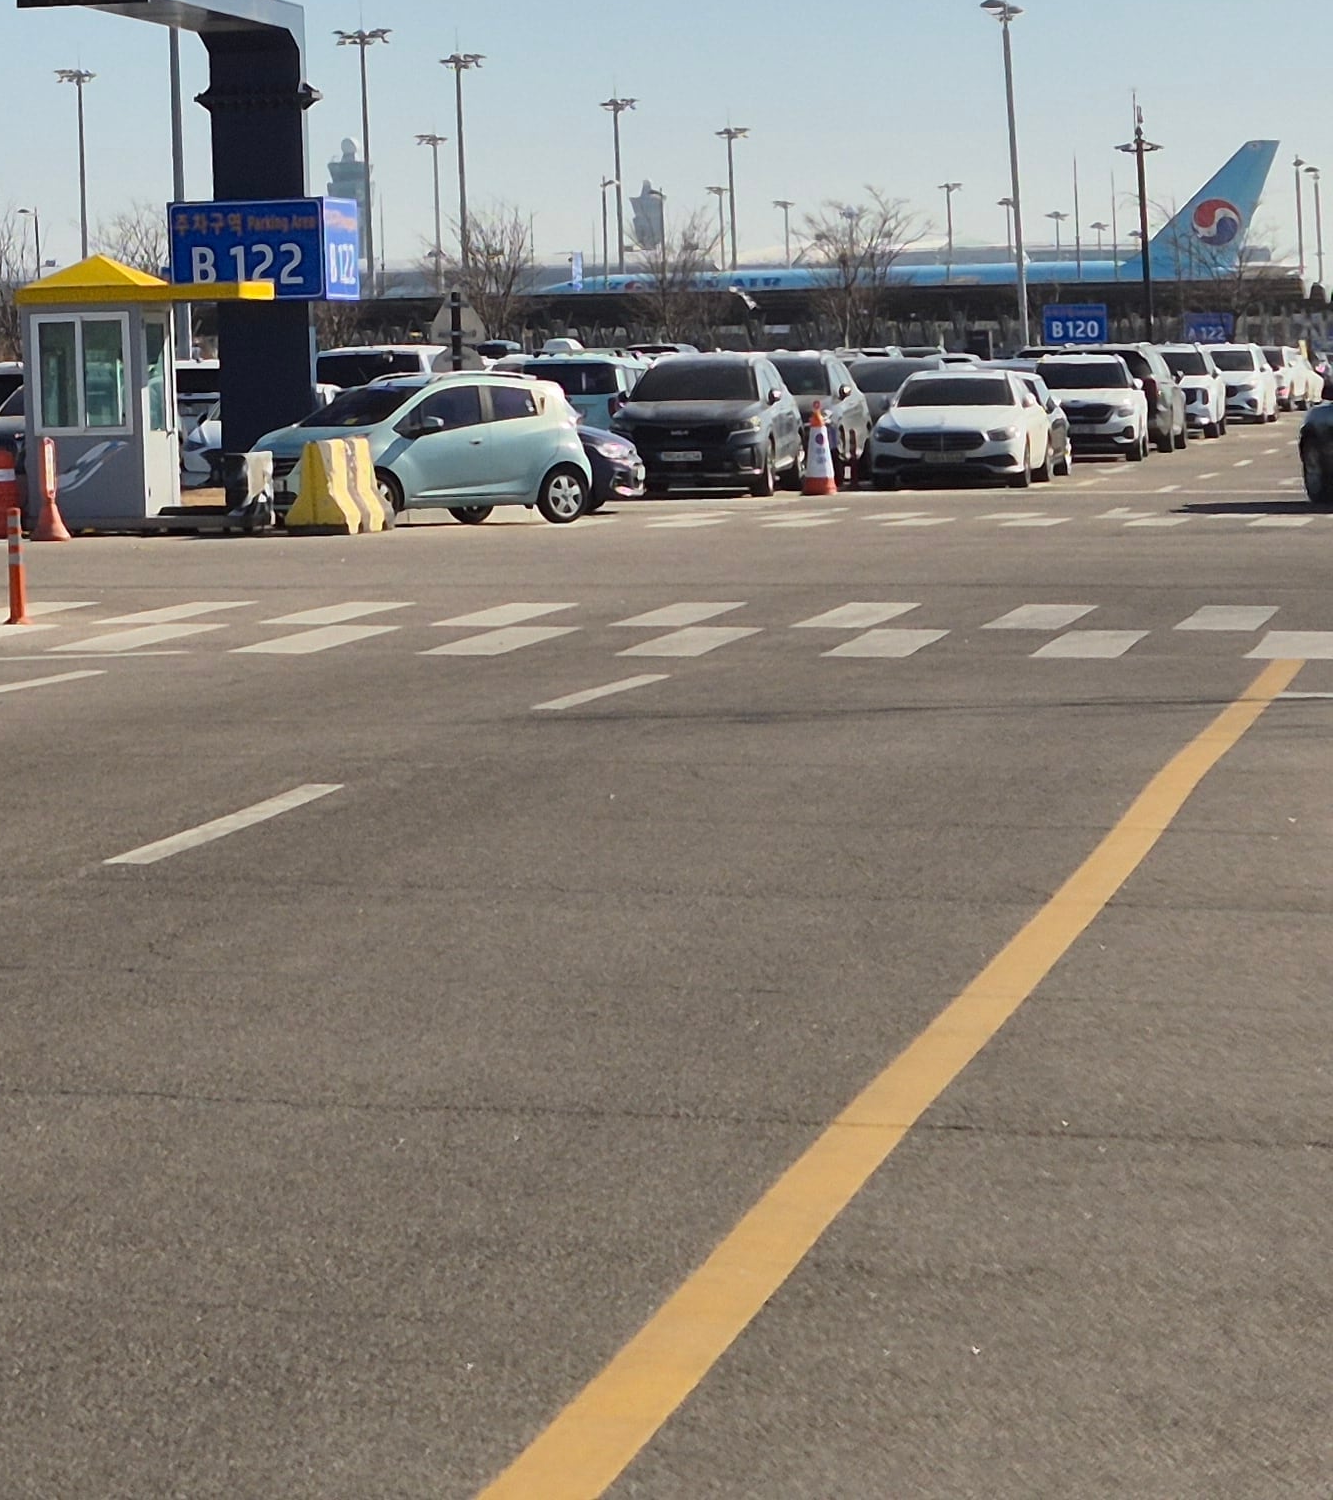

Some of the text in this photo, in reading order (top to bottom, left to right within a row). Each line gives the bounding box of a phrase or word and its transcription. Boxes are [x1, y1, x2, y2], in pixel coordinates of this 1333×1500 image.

[175, 212, 244, 238] 주차구역
[291, 213, 317, 230] Area
[191, 242, 304, 285] B 122
[732, 277, 782, 289] AIR
[1051, 320, 1100, 338] B 120
[1200, 326, 1226, 341] 122
